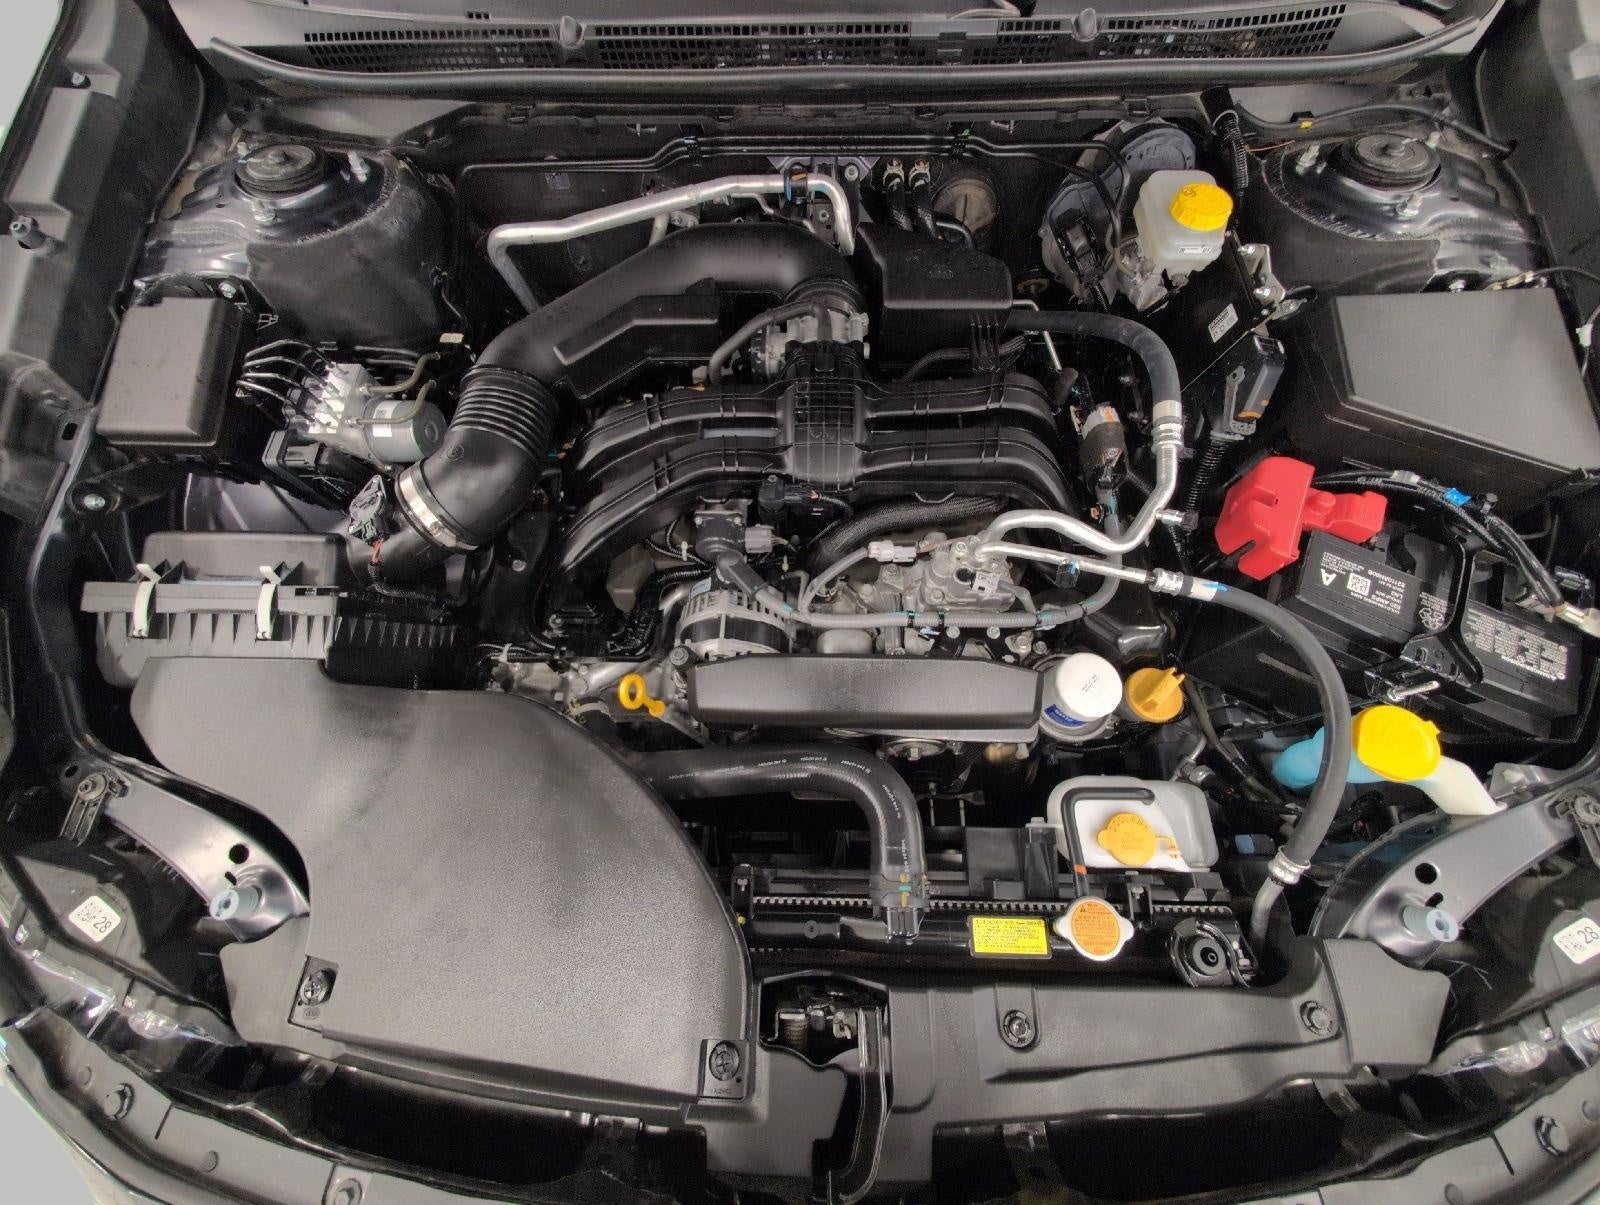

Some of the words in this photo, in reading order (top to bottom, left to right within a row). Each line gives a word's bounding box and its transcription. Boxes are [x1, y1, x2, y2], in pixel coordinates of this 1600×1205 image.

[1321, 568, 1336, 586] A
[1370, 594, 1389, 605] AMPS
[93, 916, 112, 933] 28
[1577, 926, 1600, 944] 28
